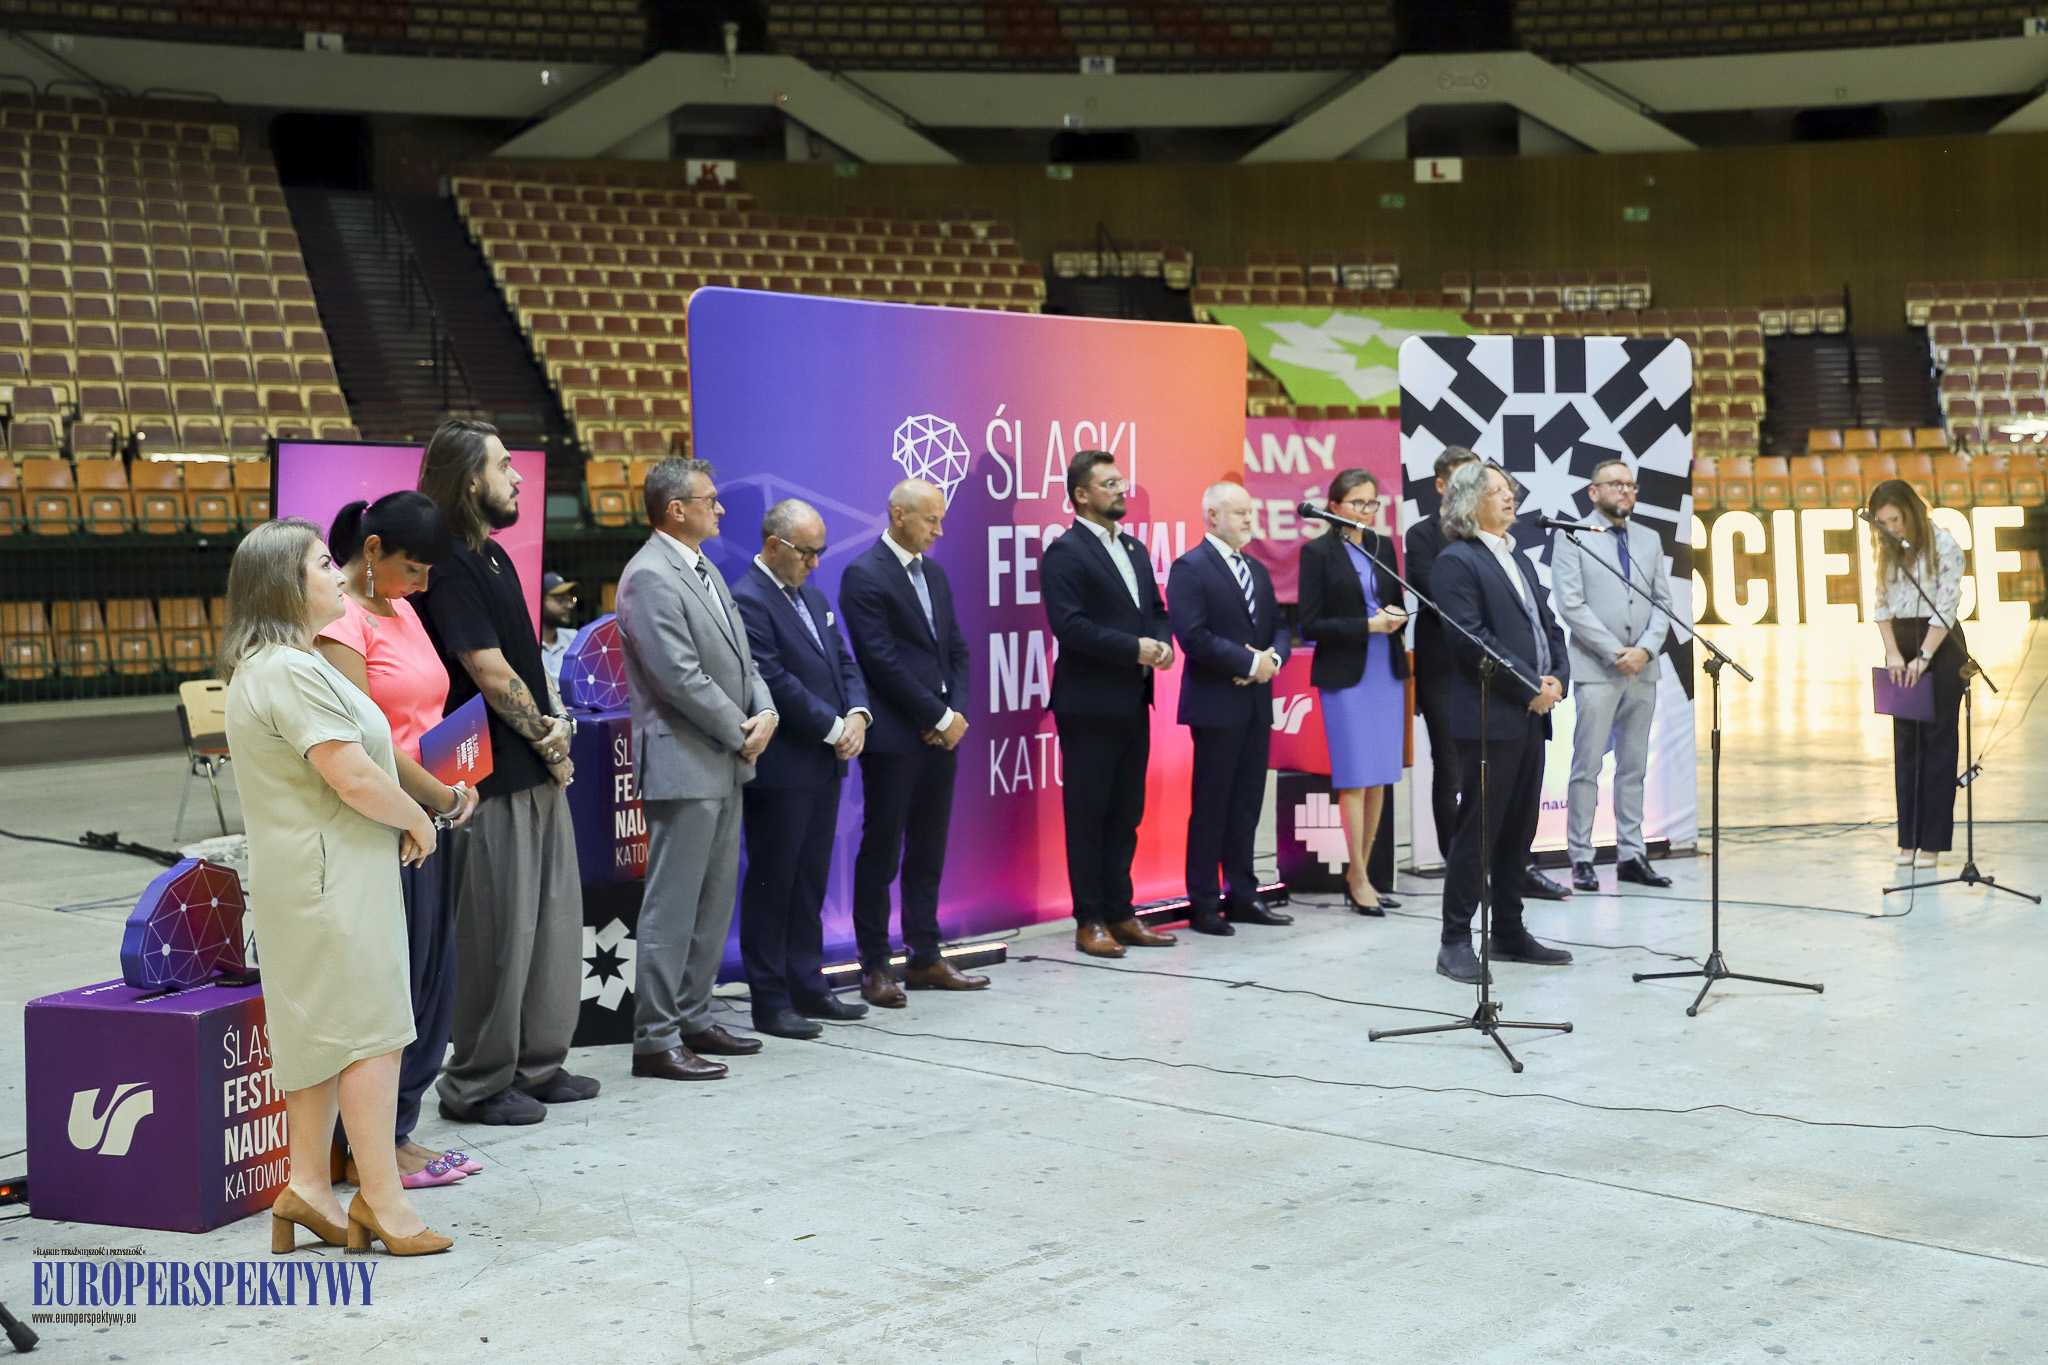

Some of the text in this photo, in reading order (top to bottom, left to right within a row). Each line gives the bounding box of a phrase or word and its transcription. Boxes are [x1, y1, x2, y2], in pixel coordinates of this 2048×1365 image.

[1692, 506, 2031, 625] CIEE
[615, 808, 647, 839] NAU
[615, 843, 649, 866] KATO
[223, 1024, 272, 1069] ŚLĄS
[223, 1067, 286, 1118] FEST
[223, 1110, 288, 1166] NAUKI
[224, 1156, 291, 1203] KATOWIC
